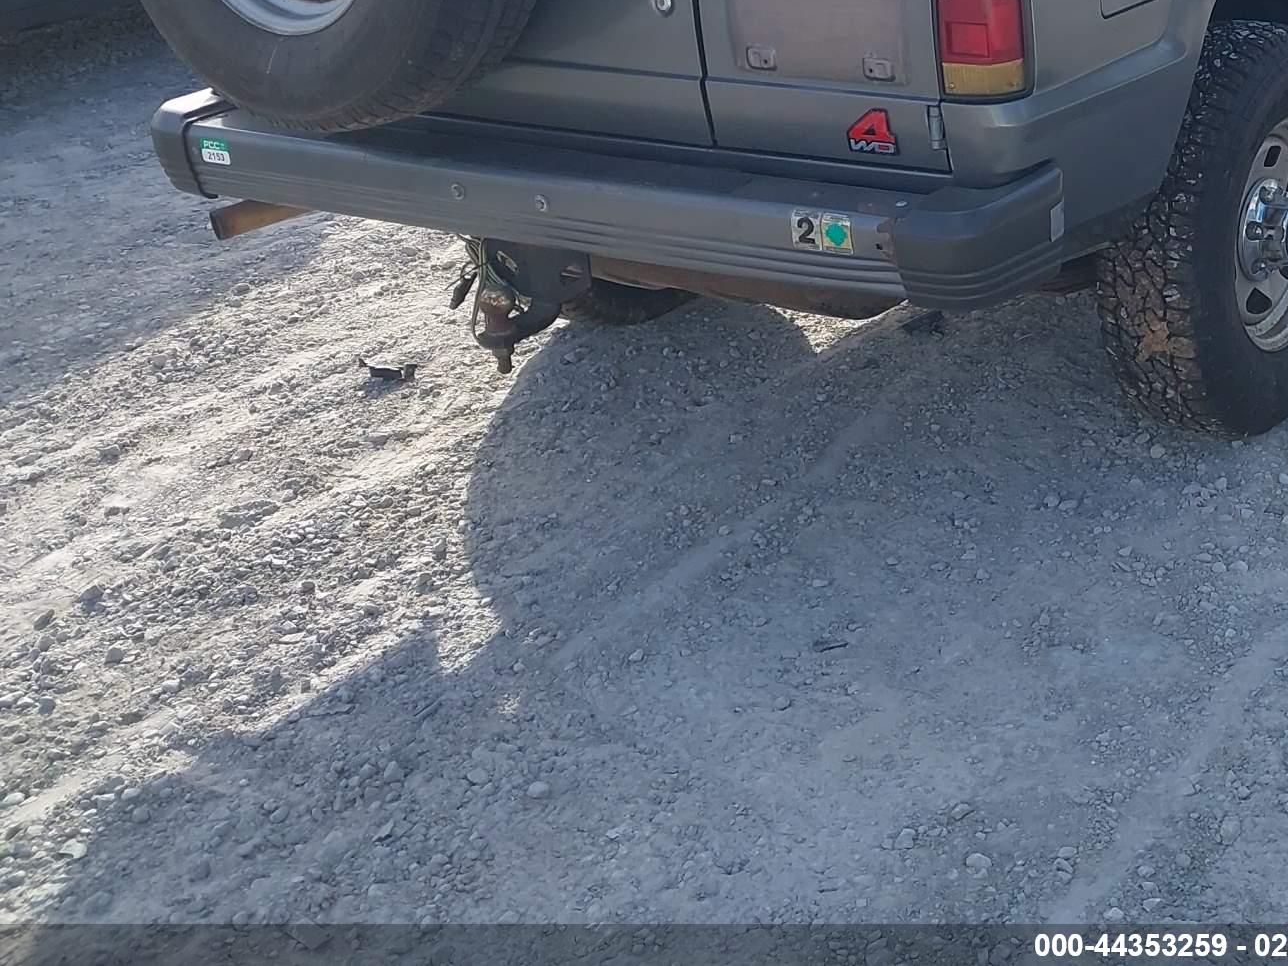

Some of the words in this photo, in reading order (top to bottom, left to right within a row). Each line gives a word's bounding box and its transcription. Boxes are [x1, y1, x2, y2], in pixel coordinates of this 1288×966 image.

[847, 109, 897, 144] 4
[207, 151, 225, 162] 2153
[797, 216, 816, 245] 2
